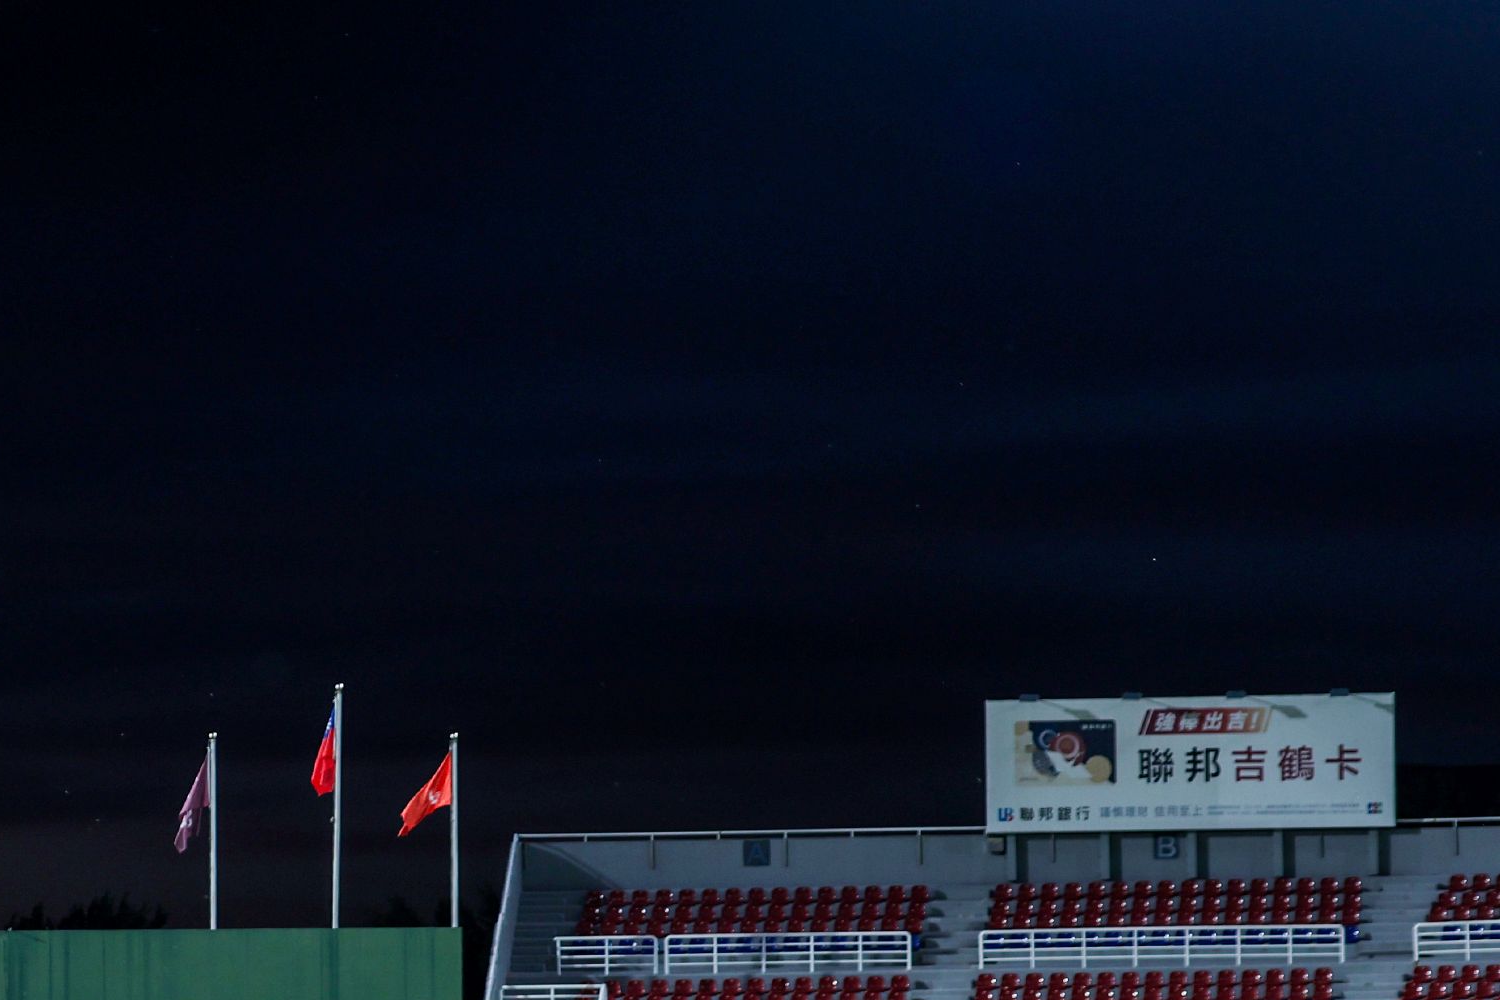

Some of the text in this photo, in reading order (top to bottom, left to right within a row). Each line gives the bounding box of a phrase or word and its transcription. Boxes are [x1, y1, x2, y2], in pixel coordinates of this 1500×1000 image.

[1138, 744, 1362, 783] 聯邦吉鶴卡
[1020, 806, 1090, 821] 聯邦銀行
[1157, 836, 1177, 857] B
